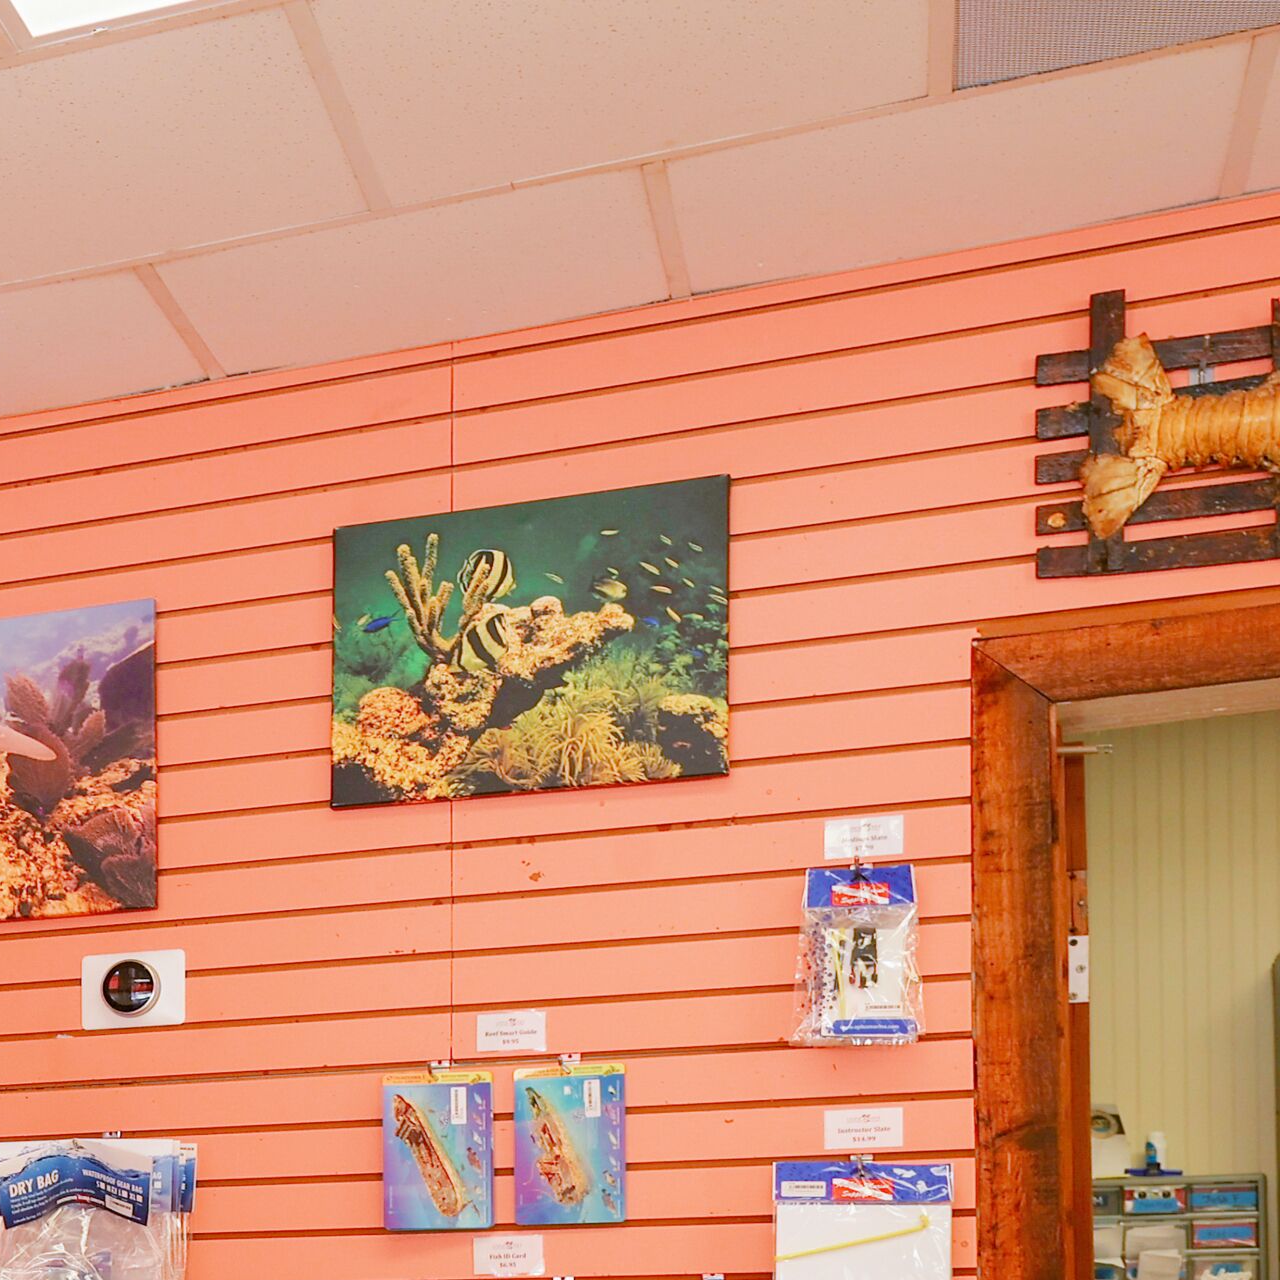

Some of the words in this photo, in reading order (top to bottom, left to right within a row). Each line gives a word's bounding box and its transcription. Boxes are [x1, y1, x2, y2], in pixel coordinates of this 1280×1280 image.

[9, 1180, 34, 1198] DRY
[37, 1169, 60, 1190] BAG
[82, 1169, 116, 1184] WATERPROOF
[117, 1179, 130, 1190] GEAR
[131, 1182, 144, 1194] BAG
